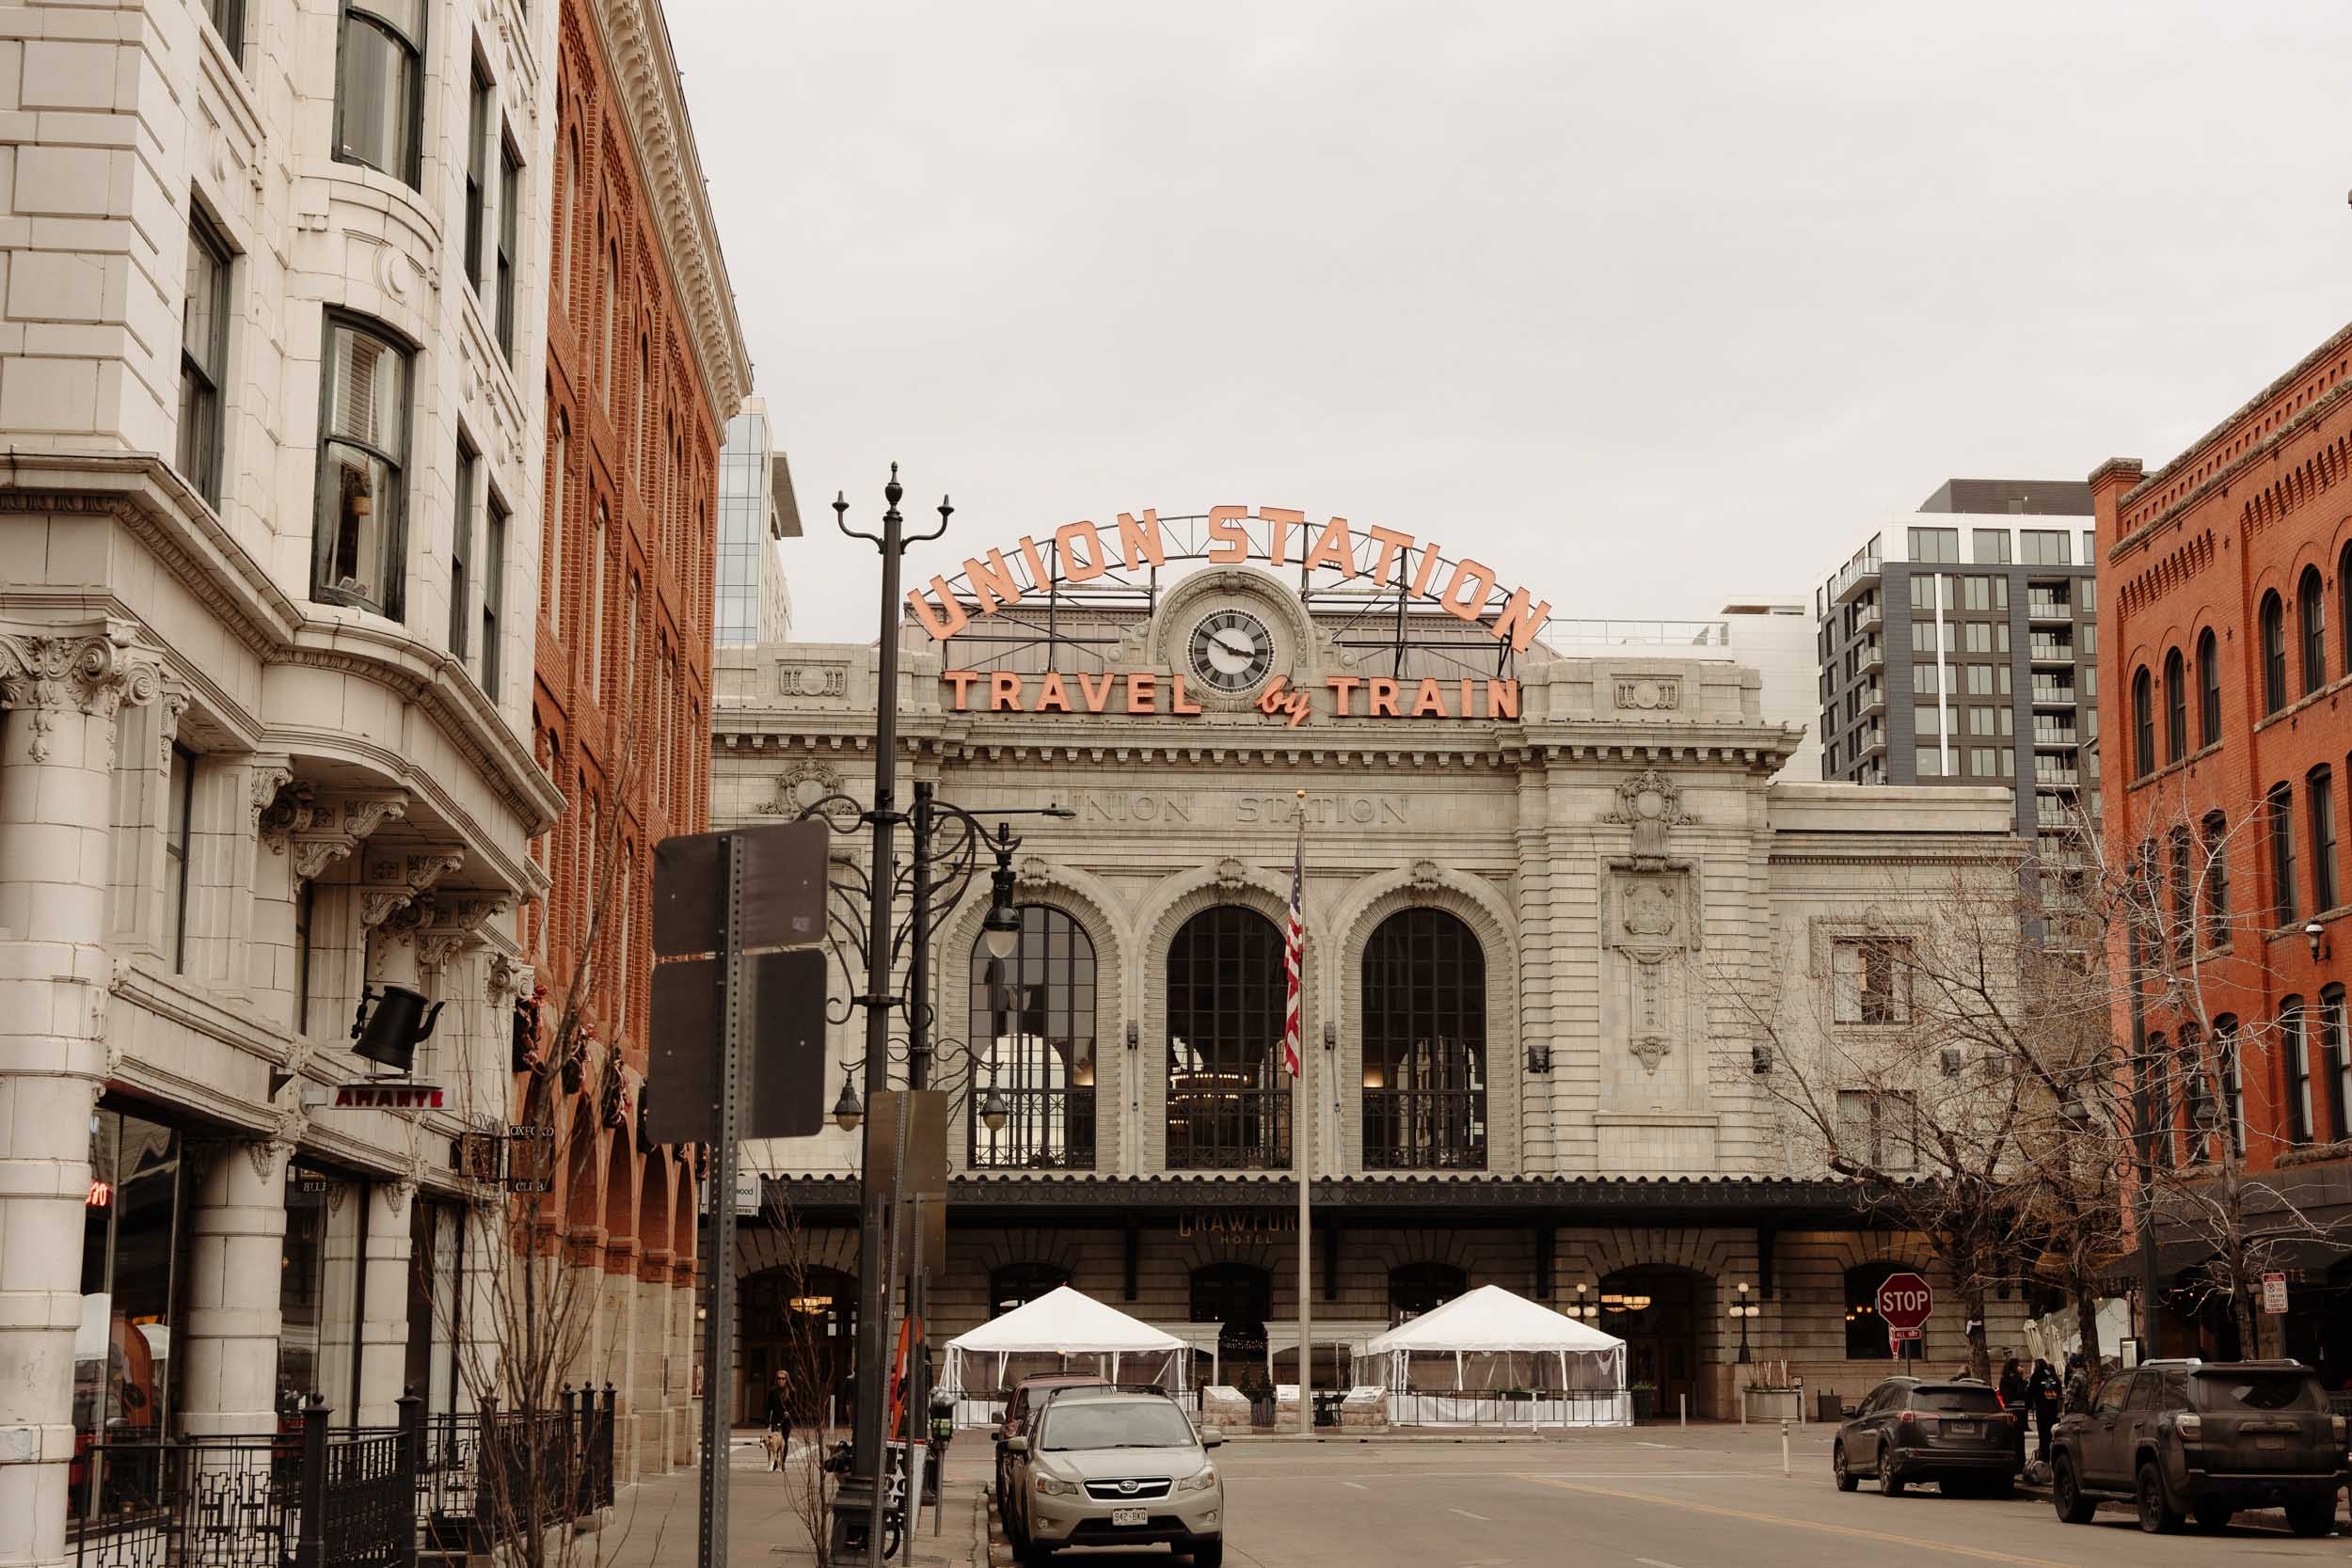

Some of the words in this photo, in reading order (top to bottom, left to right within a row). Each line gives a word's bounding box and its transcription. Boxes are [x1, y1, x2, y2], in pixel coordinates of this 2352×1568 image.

[907, 508, 1166, 641] UNION
[1208, 504, 1551, 654] STATION
[944, 670, 1201, 714] TRAVEL
[1256, 674, 1311, 727] by
[1327, 675, 1518, 719] TRAIN
[1235, 796, 1409, 824] STATION
[1180, 1210, 1297, 1237] CRAWFOR
[1221, 1235, 1272, 1243] HOTEL
[1883, 1291, 1928, 1312] STOP
